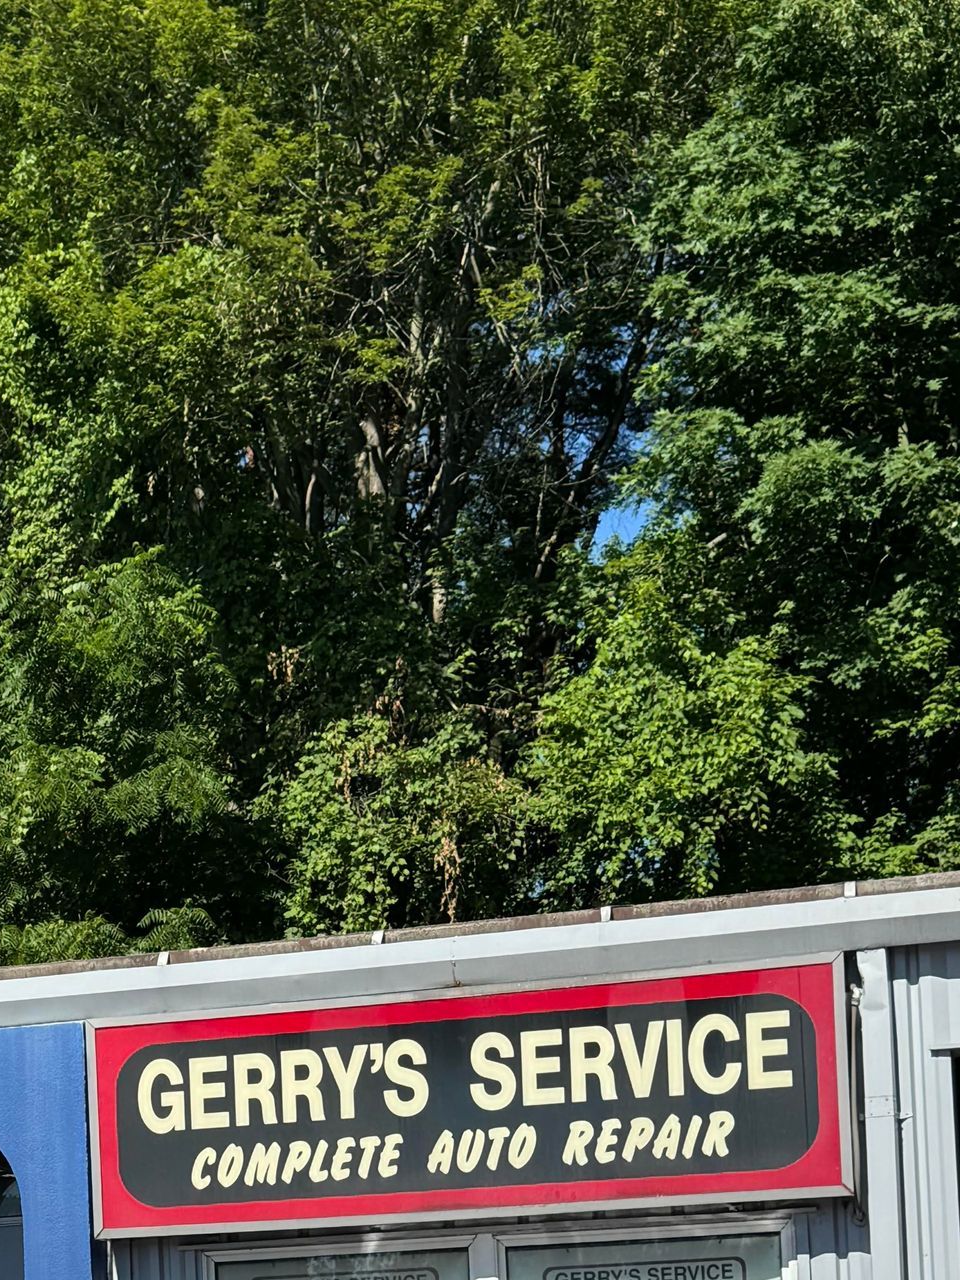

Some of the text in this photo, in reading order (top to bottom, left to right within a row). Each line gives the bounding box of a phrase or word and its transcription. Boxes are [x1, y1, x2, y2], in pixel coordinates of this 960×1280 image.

[137, 1010, 793, 1135] GERRY'S SERVICE
[191, 1110, 735, 1190] COMPLETE AUTO REPAIR
